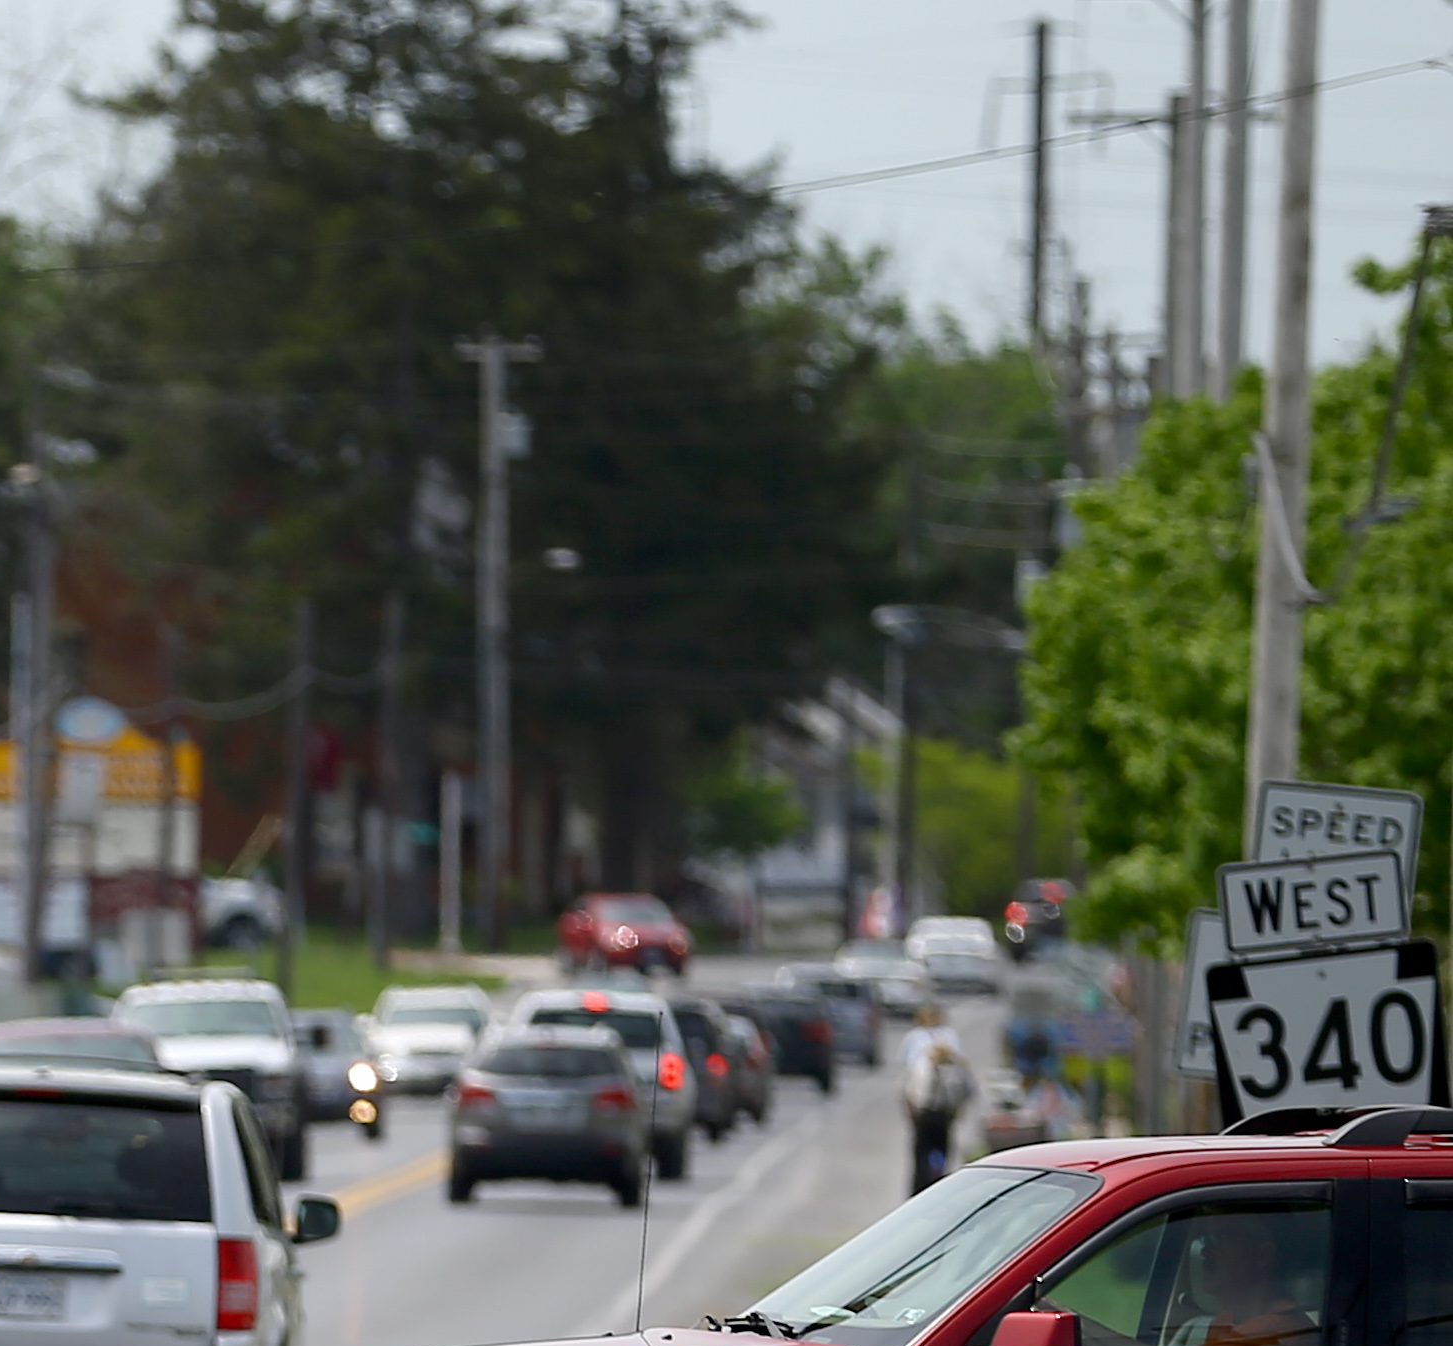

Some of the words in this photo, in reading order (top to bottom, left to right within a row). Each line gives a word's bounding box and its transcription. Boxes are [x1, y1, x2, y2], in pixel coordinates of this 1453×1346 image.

[1271, 805, 1404, 848] SPEED
[1243, 872, 1382, 935] WEST
[1235, 987, 1427, 1099] 340
